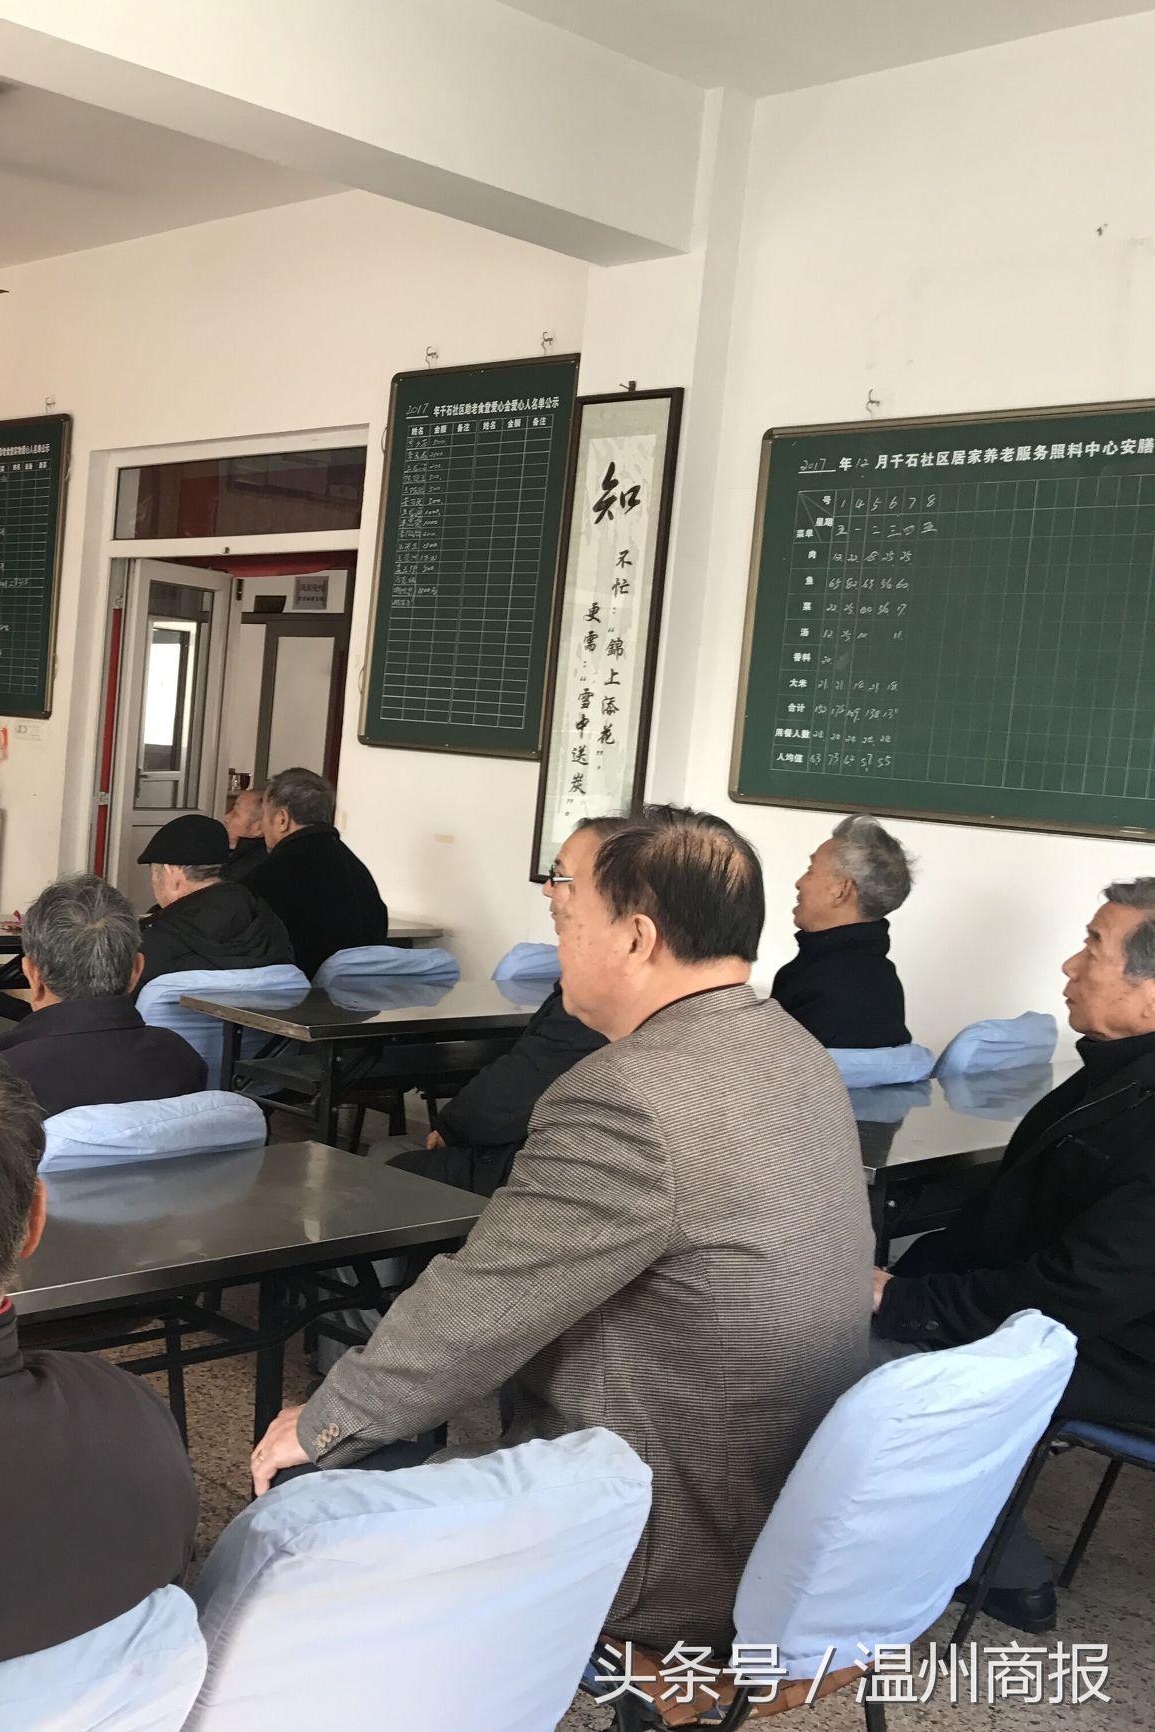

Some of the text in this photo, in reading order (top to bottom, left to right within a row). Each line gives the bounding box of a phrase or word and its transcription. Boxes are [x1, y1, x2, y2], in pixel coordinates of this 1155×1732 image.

[593, 461, 641, 525] 知
[822, 495, 832, 505] 号
[841, 494, 936, 511] 1 4 5 6 7 8
[815, 517, 833, 527] 星期
[796, 529, 814, 539] 菜单
[871, 525, 881, 534] 二
[887, 524, 902, 538] 三
[789, 678, 808, 688] 大米
[788, 702, 806, 713] 合计
[774, 728, 811, 739] 用餐人数
[776, 752, 804, 763] 人均值
